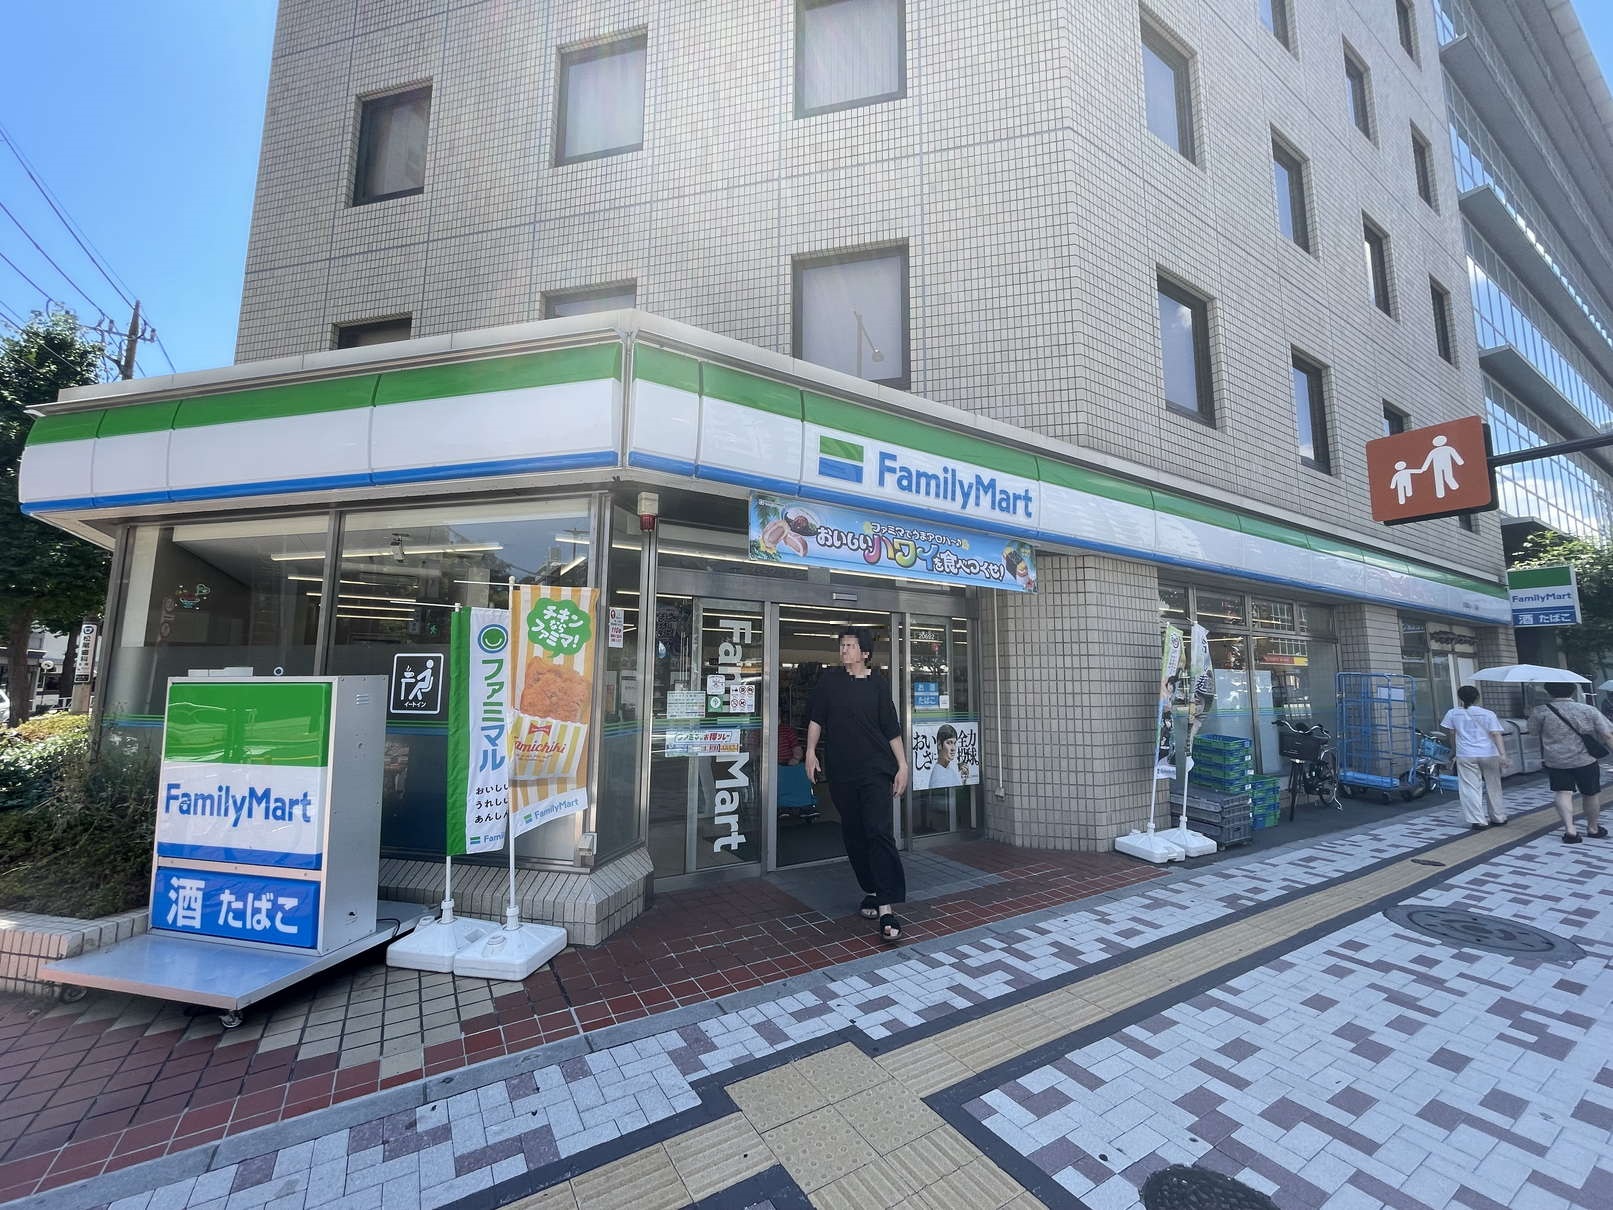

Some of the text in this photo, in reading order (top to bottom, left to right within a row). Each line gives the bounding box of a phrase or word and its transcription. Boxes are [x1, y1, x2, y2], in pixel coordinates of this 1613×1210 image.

[878, 451, 1032, 518] FamilyMart
[1512, 592, 1572, 603] FamilyMart
[543, 605, 584, 627] チキン
[549, 620, 567, 633] なら
[1519, 613, 1571, 624] 酒 たばこ
[531, 618, 580, 648] ファミマ!
[479, 658, 506, 773] ファミマル
[957, 728, 977, 748] 全力
[164, 783, 312, 828] FamilyMart
[534, 798, 579, 820] FamilyMart
[166, 876, 299, 934] 酒 たばこ
